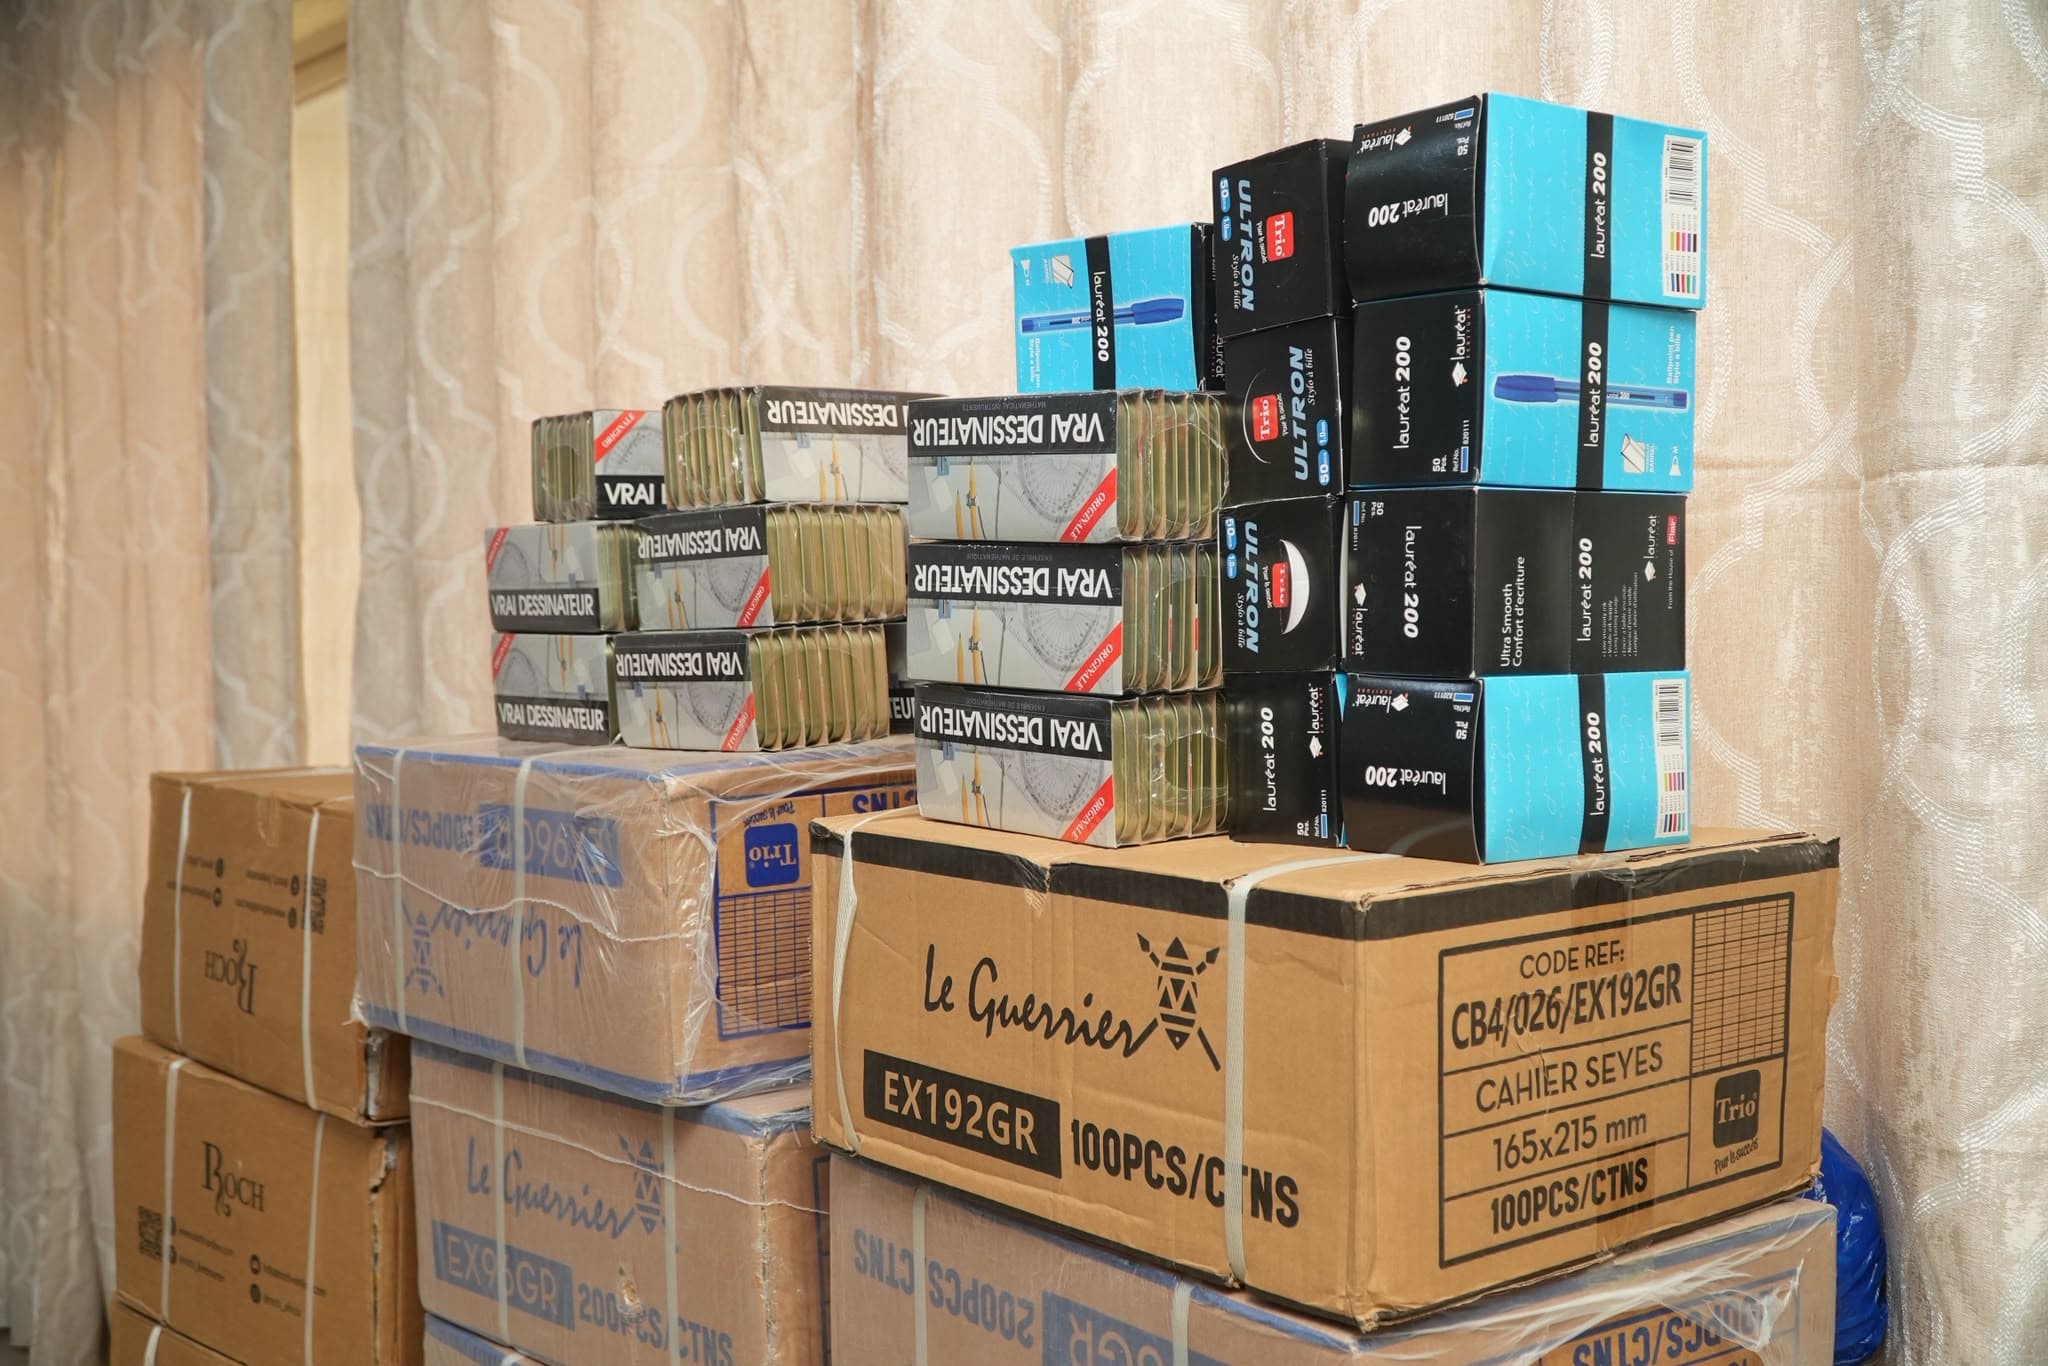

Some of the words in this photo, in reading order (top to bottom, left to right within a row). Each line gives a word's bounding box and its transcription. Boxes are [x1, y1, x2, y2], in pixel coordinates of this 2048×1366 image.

[1360, 133, 1395, 152] lauréat
[1457, 144, 1469, 155] 50
[1592, 152, 1607, 195] 200
[1368, 202, 1400, 227] 200
[1402, 192, 1448, 218] lauréat
[1238, 179, 1254, 312] ULTRON
[1274, 215, 1286, 257] Trio
[1591, 205, 1606, 258] lauréat
[1231, 254, 1241, 279] Stylo
[1093, 271, 1107, 323] lauréat
[1233, 289, 1241, 310] bille
[1096, 325, 1109, 362] 200
[1450, 308, 1466, 360] lauréat
[1215, 335, 1225, 378] auréat
[1305, 348, 1313, 369] bille
[1395, 335, 1411, 381] 200
[1587, 341, 1602, 385] 200
[1288, 346, 1308, 481] ULTRON
[1306, 380, 1316, 405] Stylo
[767, 400, 899, 428] DESSINATEUR
[913, 414, 1043, 447] DESSINATEUR
[1050, 412, 1104, 444] VRAI
[1259, 399, 1271, 440] Trio
[1393, 382, 1410, 449] lauréat
[1583, 392, 1600, 448] lauréat
[1320, 464, 1329, 484] 50
[1433, 458, 1440, 472] 50
[604, 482, 654, 506] VRAI
[1376, 501, 1384, 516] 50
[1068, 491, 1107, 541] ORIGINALE
[1643, 514, 1657, 559] lauréat
[1668, 517, 1677, 543] Flair
[637, 529, 722, 559] DESSINATEUR
[725, 526, 761, 553] VRAI
[1404, 525, 1422, 588] lauréat
[1578, 537, 1593, 580] 200
[914, 564, 1050, 597] DESSINATEUR
[1057, 567, 1113, 599] VRAI
[1245, 521, 1259, 653] ULTRON
[1514, 555, 1525, 616] d'ecriture
[491, 593, 517, 617] VRAI
[518, 593, 594, 617] DESSINATEUR
[1236, 593, 1246, 618] Stylo
[1403, 592, 1419, 638] 200
[1501, 583, 1513, 634] Smooth
[1576, 583, 1592, 641] lauréat
[1355, 607, 1369, 656] lauréat
[1500, 636, 1512, 667] Ultra
[1512, 618, 1524, 667] Confort
[615, 652, 703, 677] DESSINATEUR
[706, 651, 743, 676] VRAI
[1076, 643, 1114, 691] ORIGINALE
[497, 702, 525, 726] VRAI
[526, 704, 604, 731] DESSINATEUR
[1307, 687, 1320, 734] lauréat
[1355, 693, 1392, 714] lauréat
[920, 704, 1043, 746] DESSINATEUR
[1050, 718, 1102, 753] VRAI
[1260, 706, 1274, 749] 200
[1455, 729, 1468, 740] 50
[1586, 711, 1602, 754] 200
[1262, 752, 1277, 812] lauréat
[1365, 765, 1398, 788] 200
[1399, 768, 1446, 795] lauréat
[1590, 757, 1605, 816] lauréat
[1071, 796, 1105, 841] ORIGINALE
[1297, 822, 1304, 836] 50
[749, 843, 797, 869] Trio
[1520, 947, 1580, 979] CODE
[1585, 939, 1625, 971] REF:
[925, 943, 954, 1013] Le
[968, 956, 1159, 1058] Guerrier
[1451, 961, 1682, 1050] CB4/026/EX192GR
[1476, 1061, 1577, 1114] CAHIER
[1585, 1040, 1664, 1084] SEYES
[1716, 1093, 1756, 1124] Trio
[883, 1069, 1040, 1156] EX192GR
[1071, 1118, 1300, 1229] 100PCS/CNS
[1493, 1113, 1598, 1173] 165x215
[1605, 1111, 1648, 1145] mm
[504, 1147, 636, 1240] Guerrier
[1490, 1156, 1648, 1235] 100PCS/CTNS
[854, 1228, 1035, 1349] 200PCSCTNS
[578, 1282, 733, 1366] 200CS/TNS
